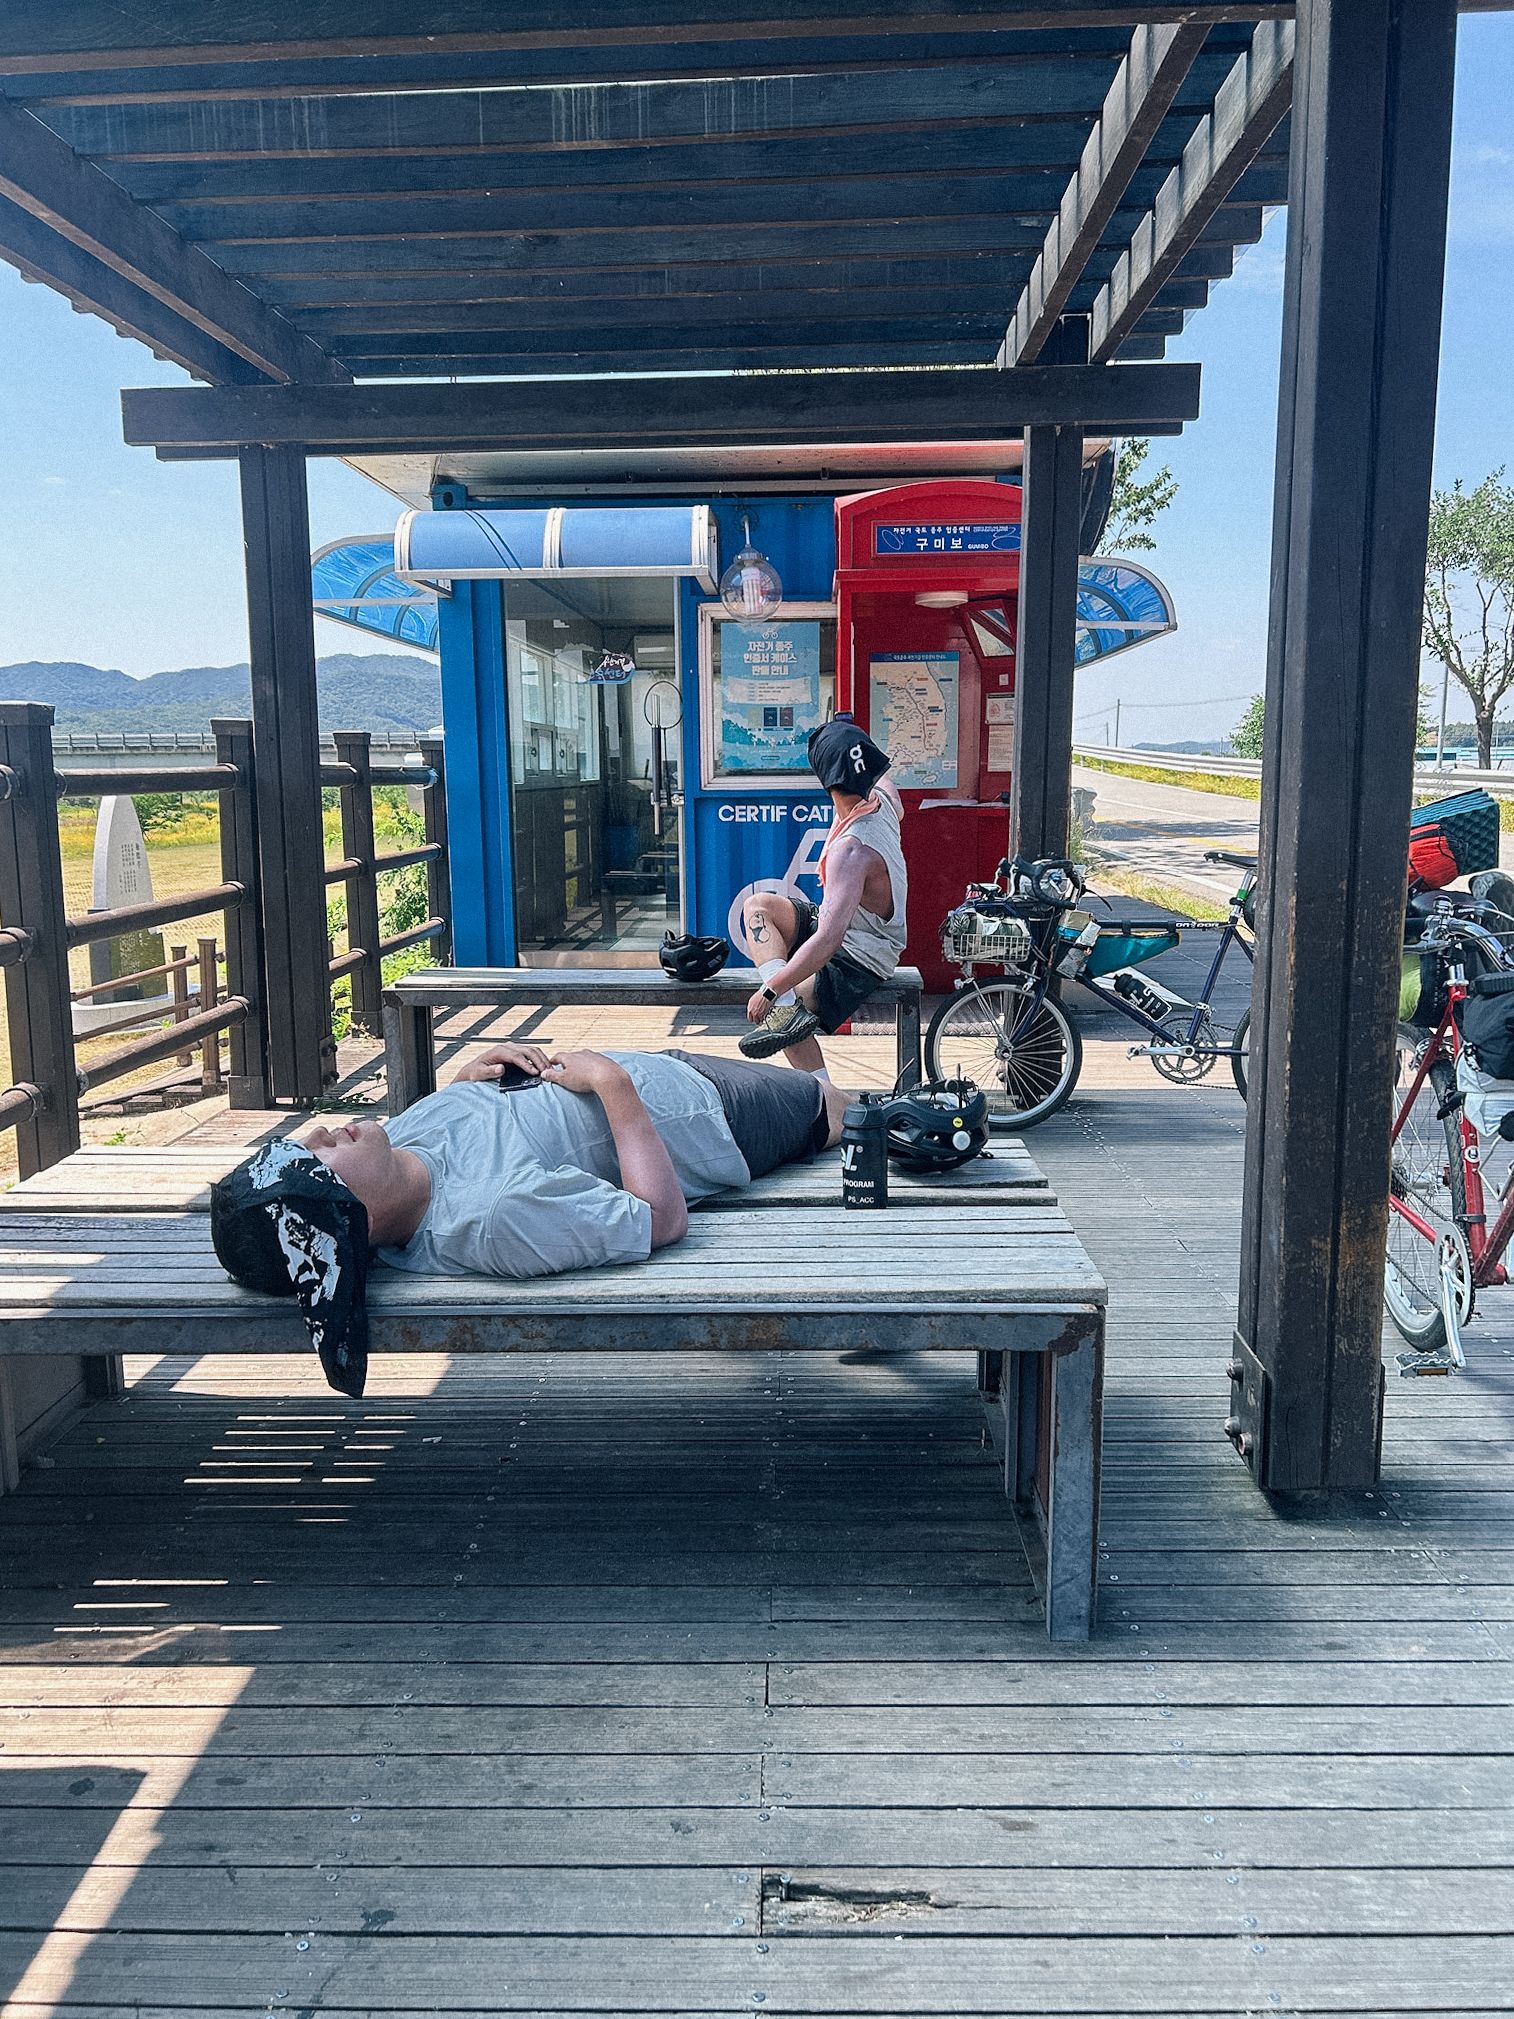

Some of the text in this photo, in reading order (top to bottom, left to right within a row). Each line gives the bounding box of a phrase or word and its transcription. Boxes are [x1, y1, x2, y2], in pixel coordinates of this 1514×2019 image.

[893, 527, 912, 535] 자전거
[916, 537, 963, 551] 구미보
[747, 641, 774, 653] 자전거
[770, 653, 798, 664] 케이스
[843, 1179, 874, 1189] PROGRAM
